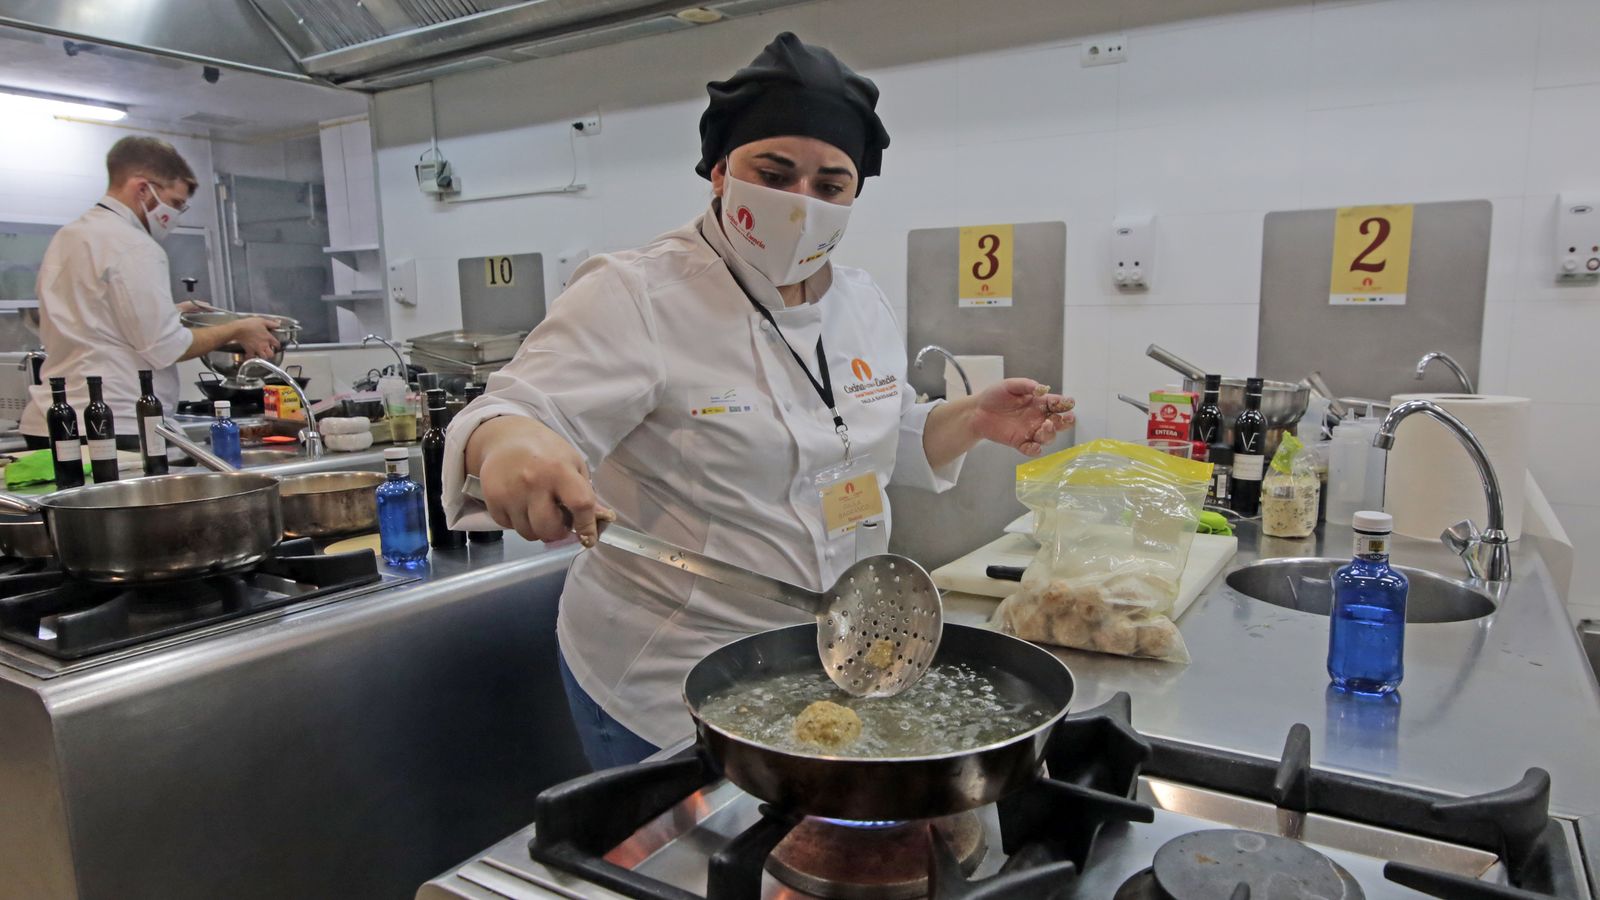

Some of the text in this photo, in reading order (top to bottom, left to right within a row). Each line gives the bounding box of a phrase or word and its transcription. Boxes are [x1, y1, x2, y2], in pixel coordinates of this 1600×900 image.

[972, 234, 1000, 280] 3
[1350, 217, 1391, 273] 2
[489, 257, 512, 284] 10
[843, 383, 866, 394] Cocina
[1155, 429, 1178, 437] ENTERA
